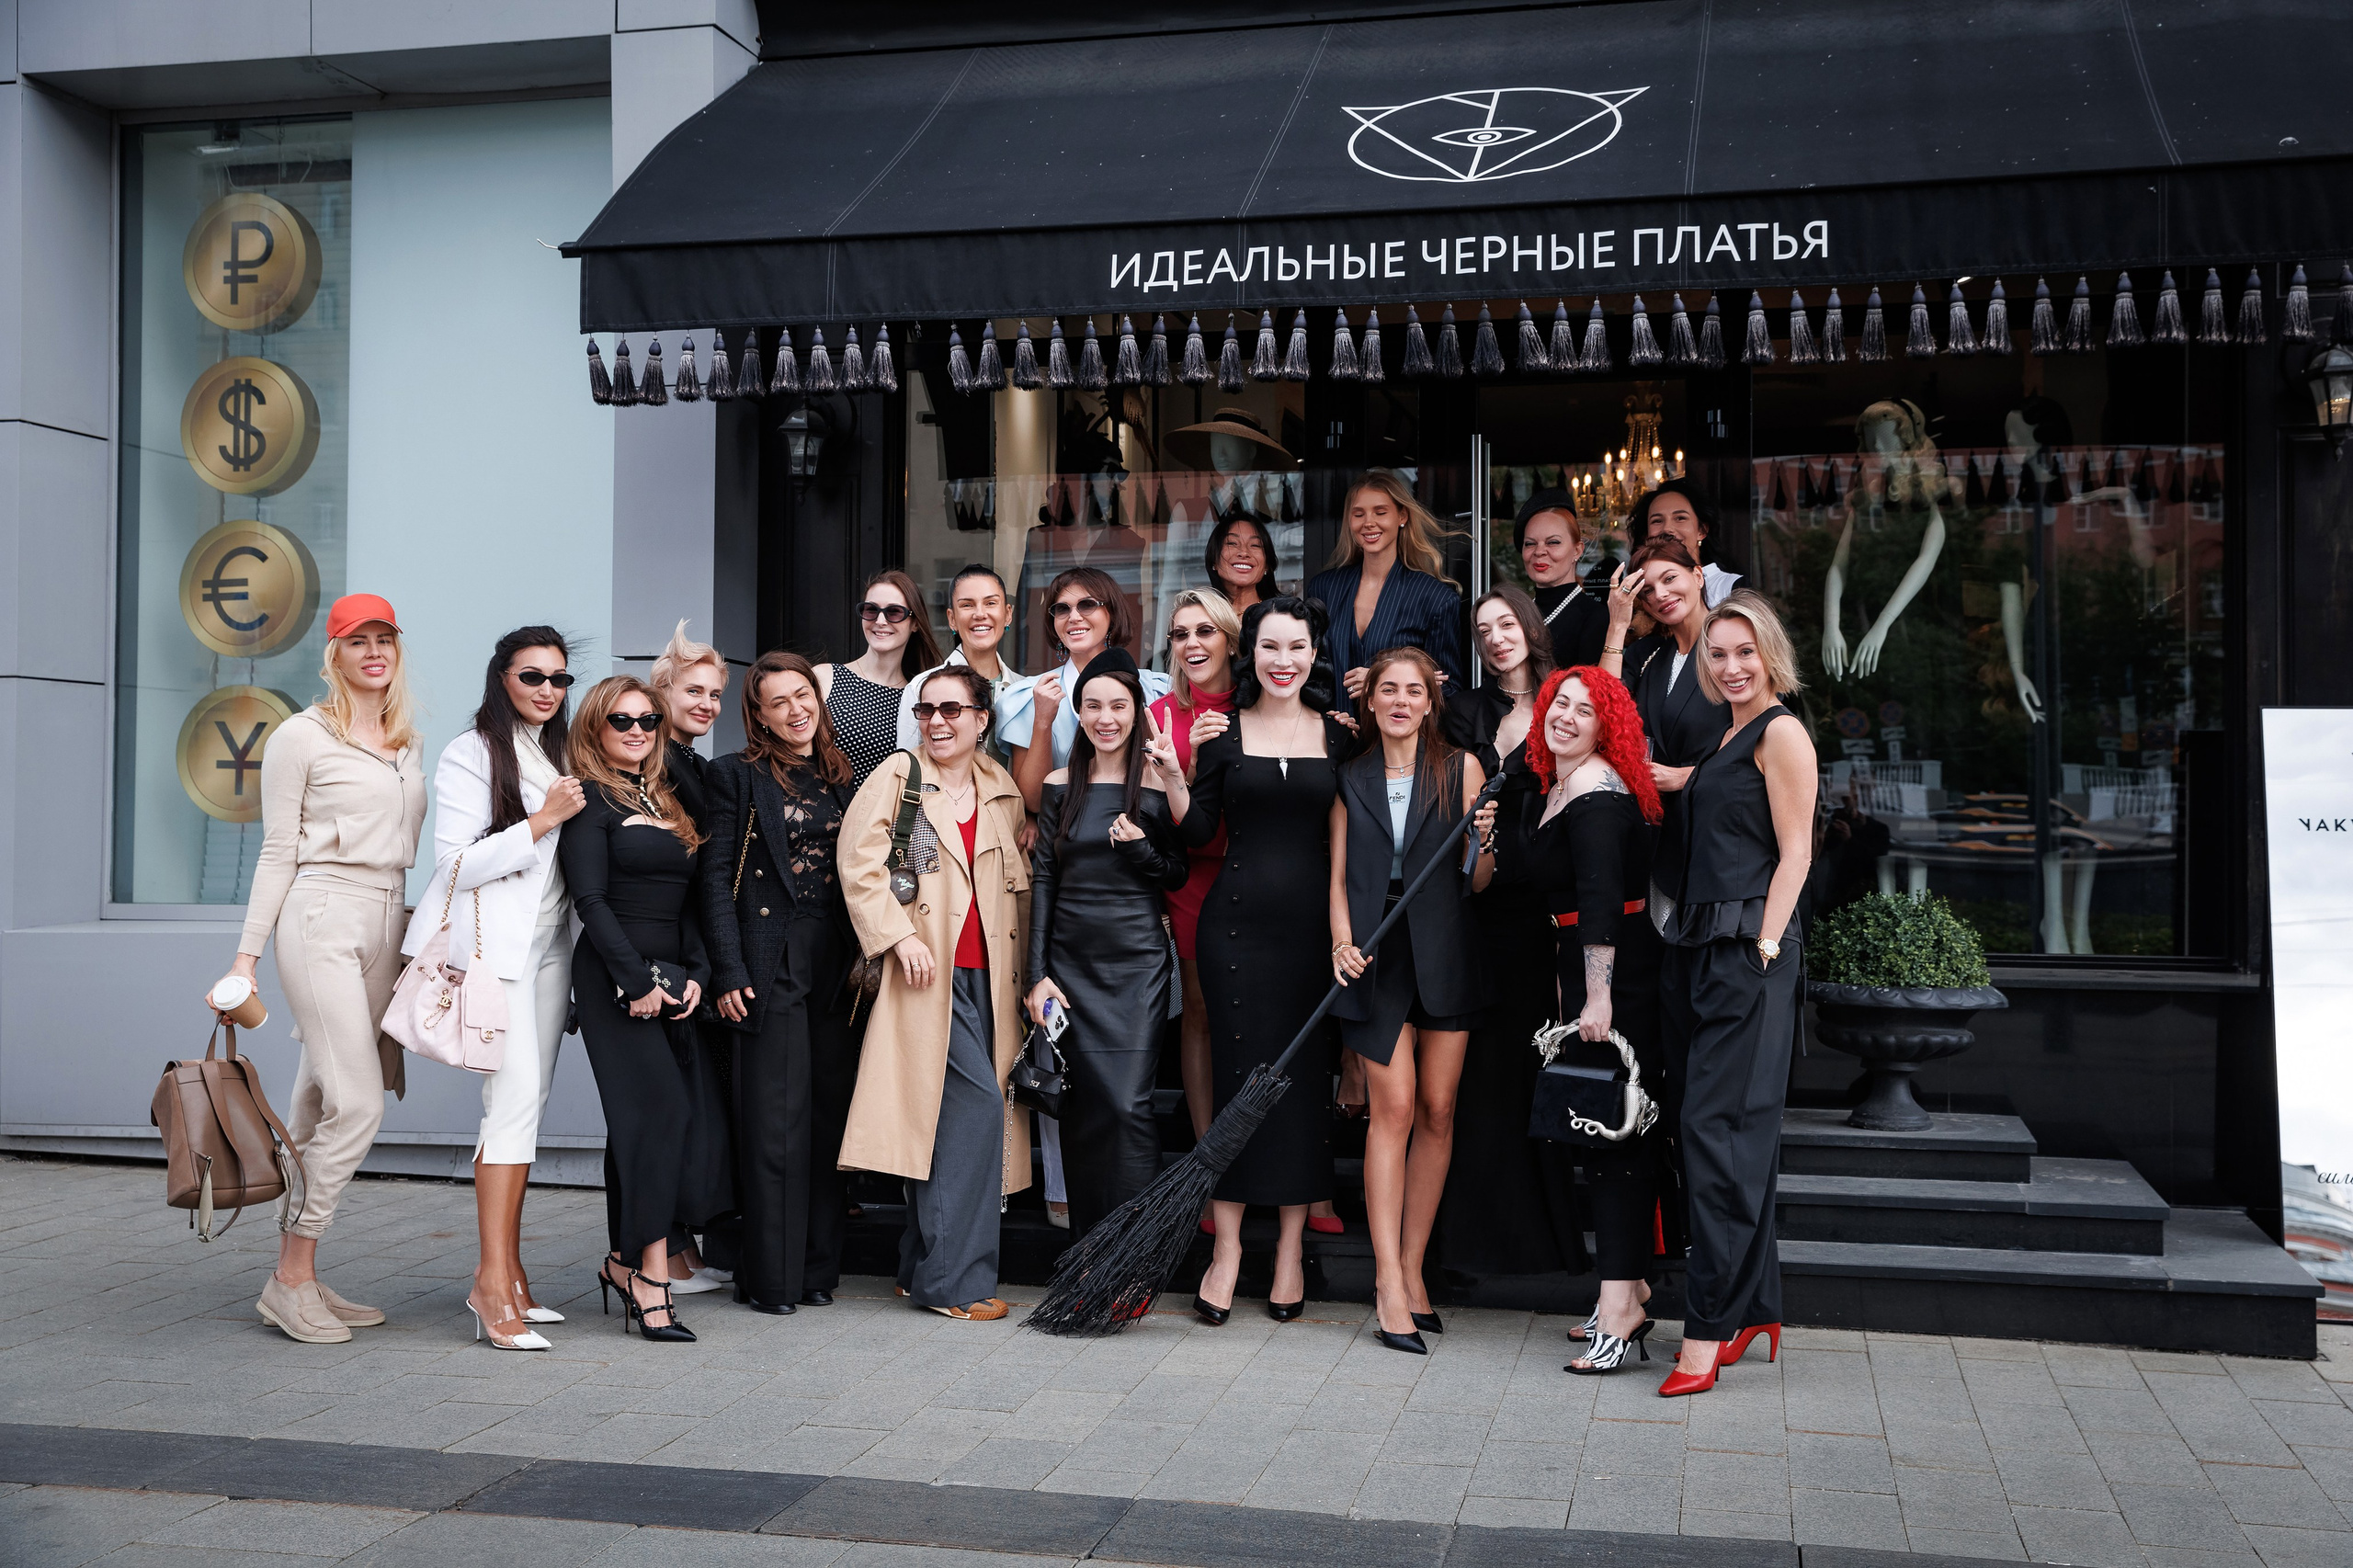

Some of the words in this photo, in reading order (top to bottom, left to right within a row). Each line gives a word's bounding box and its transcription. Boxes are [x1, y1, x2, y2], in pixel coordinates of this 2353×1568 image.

[1110, 241, 1405, 293] ИДЕАЛЬНЫЕ
[1421, 231, 1616, 275] ЧЕРНЫЕ
[1633, 221, 1828, 267] ПЛАТЬЯ
[2298, 818, 2353, 832] YAK
